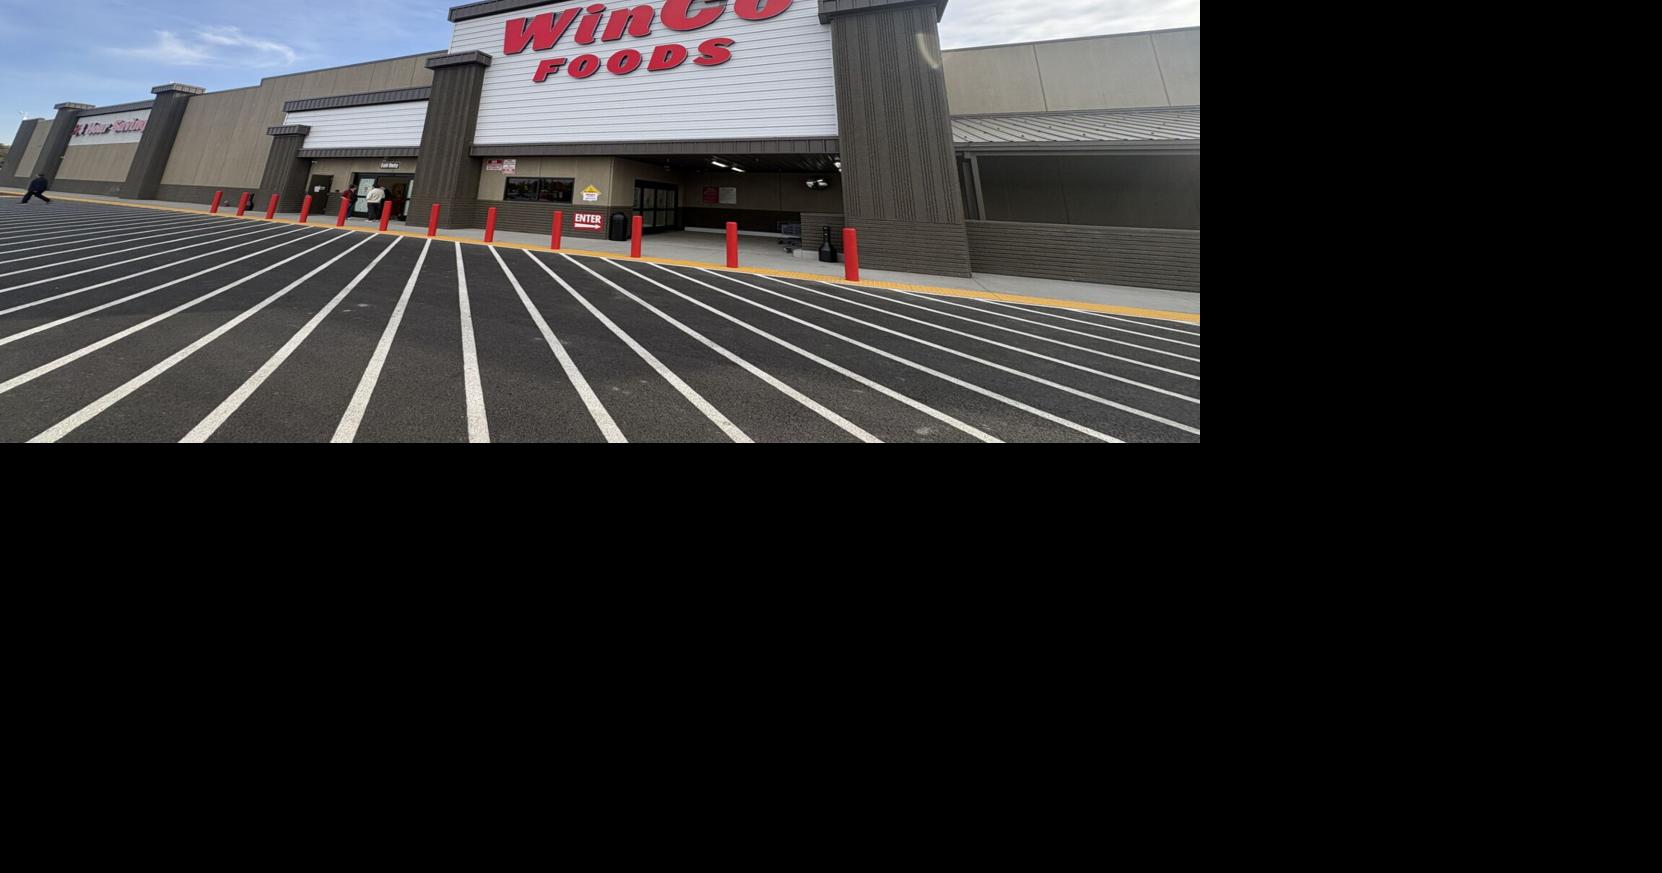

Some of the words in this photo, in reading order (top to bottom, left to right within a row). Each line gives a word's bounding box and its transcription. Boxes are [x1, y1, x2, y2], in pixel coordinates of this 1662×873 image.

[503, 0, 793, 55] WinCo
[532, 37, 736, 82] FOODS
[575, 213, 602, 224] ENTER
